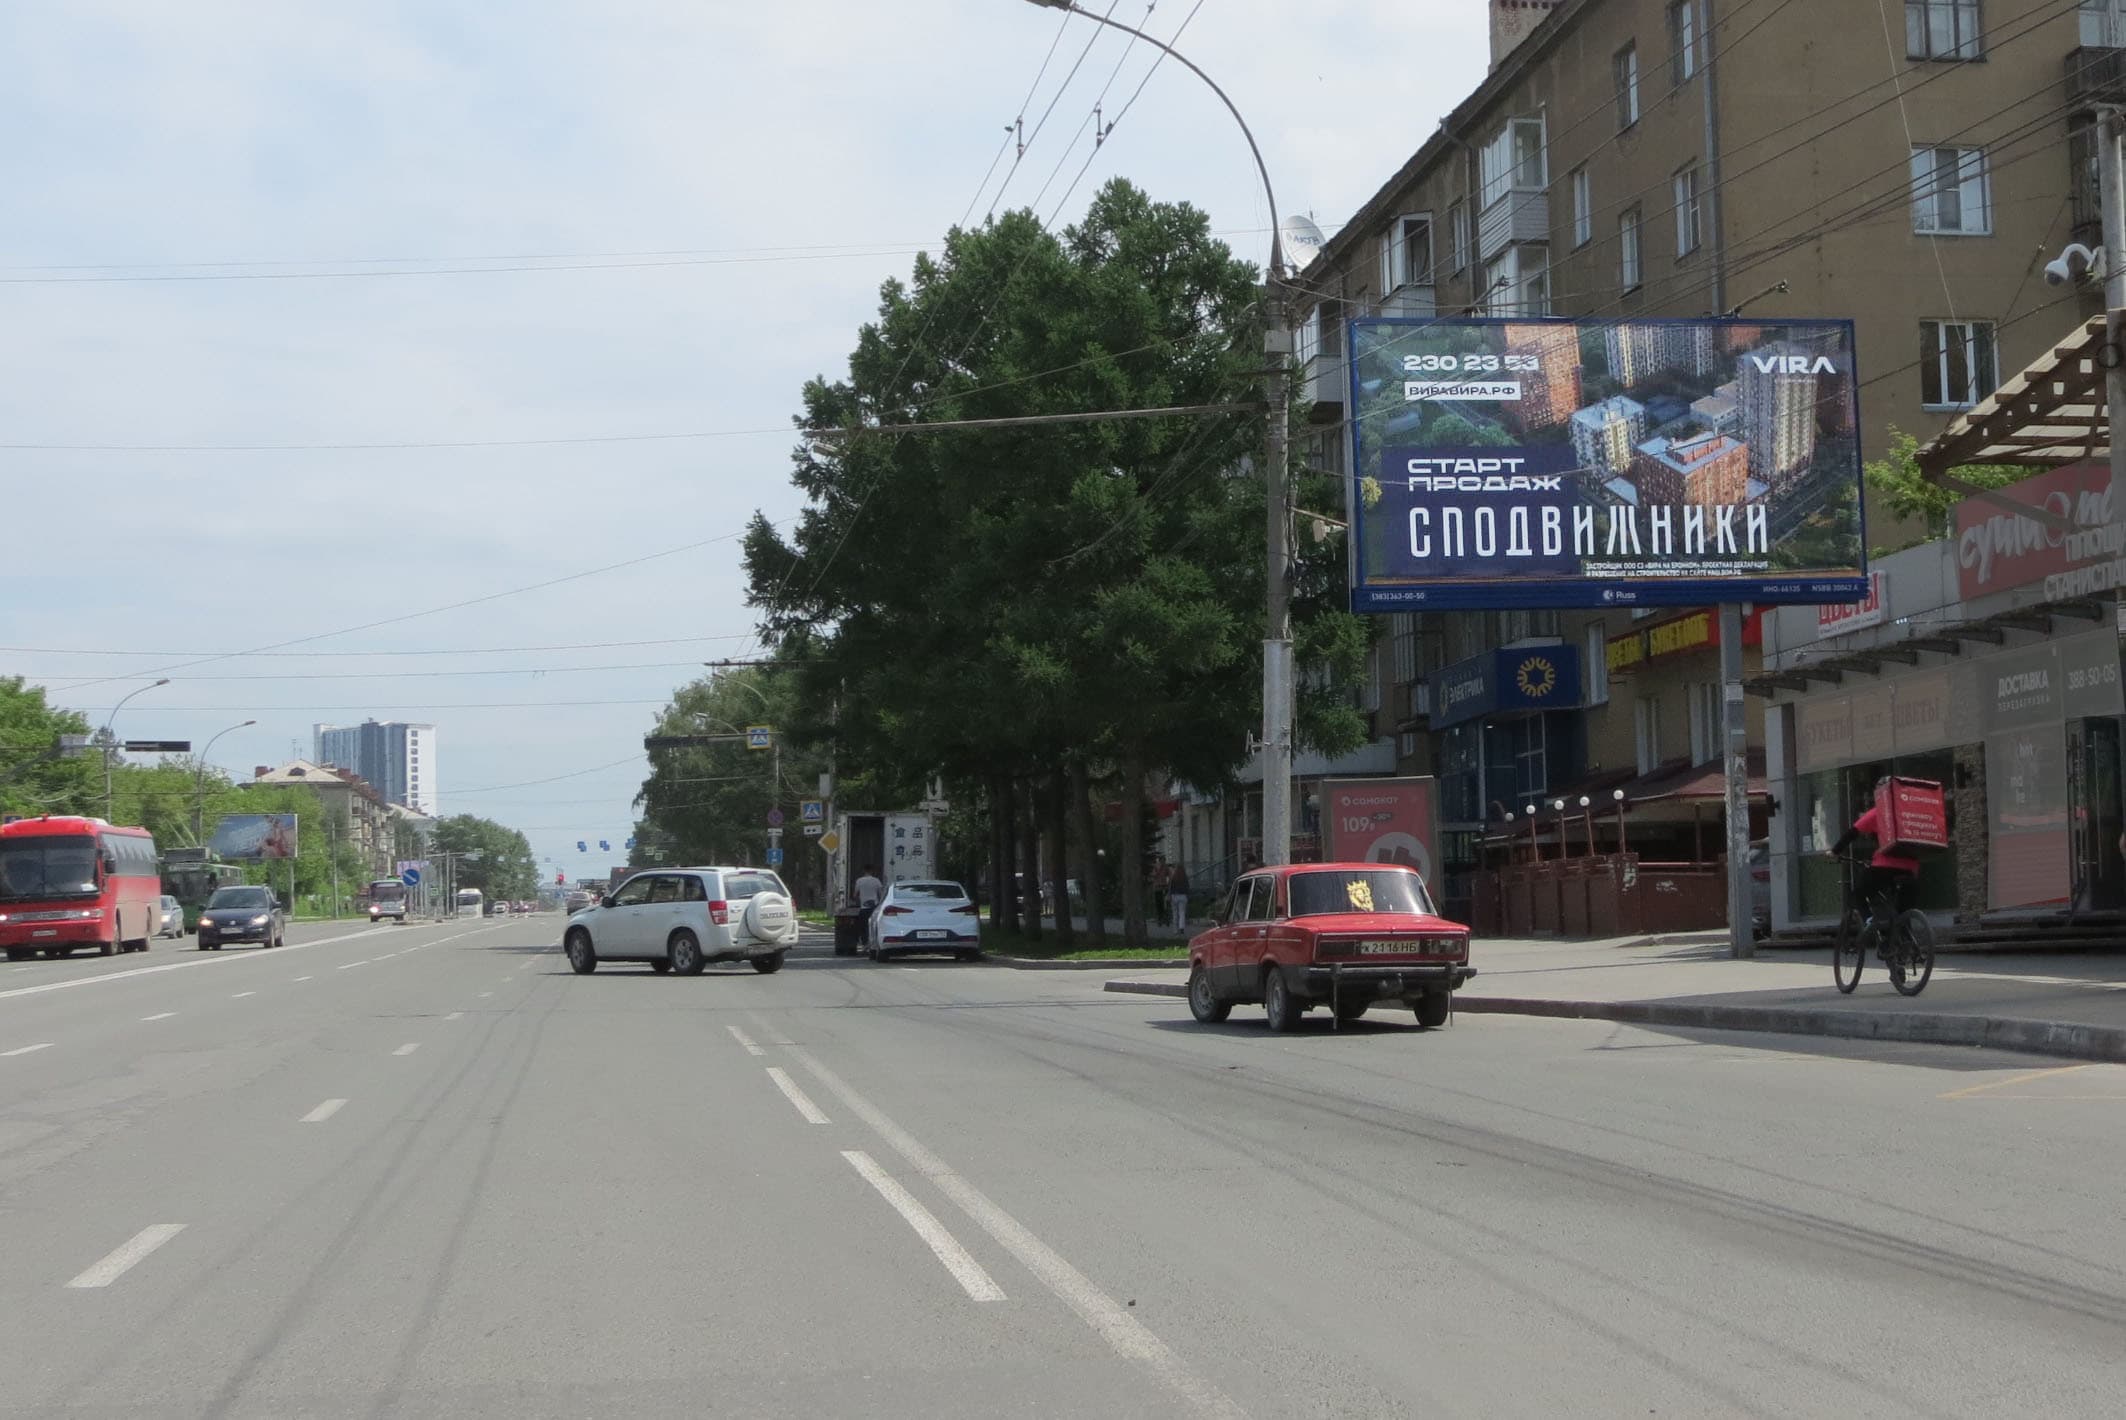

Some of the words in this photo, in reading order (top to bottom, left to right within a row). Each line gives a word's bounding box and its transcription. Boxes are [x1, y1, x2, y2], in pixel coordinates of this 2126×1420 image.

[1403, 355, 1458, 371] 230
[1463, 355, 1500, 371] 23
[1504, 355, 1539, 371] 53
[1751, 355, 1837, 375] VIRA
[1409, 386, 1516, 396] ВИРАВИРА.РФ
[1407, 458, 1525, 473] СТАРТ
[1408, 476, 1562, 492] ПРОДАЖ
[1408, 504, 1769, 558] СПОДВИЖНИКИ
[1616, 590, 1637, 600] Russ
[1998, 669, 2049, 698] ДОСТАВКА
